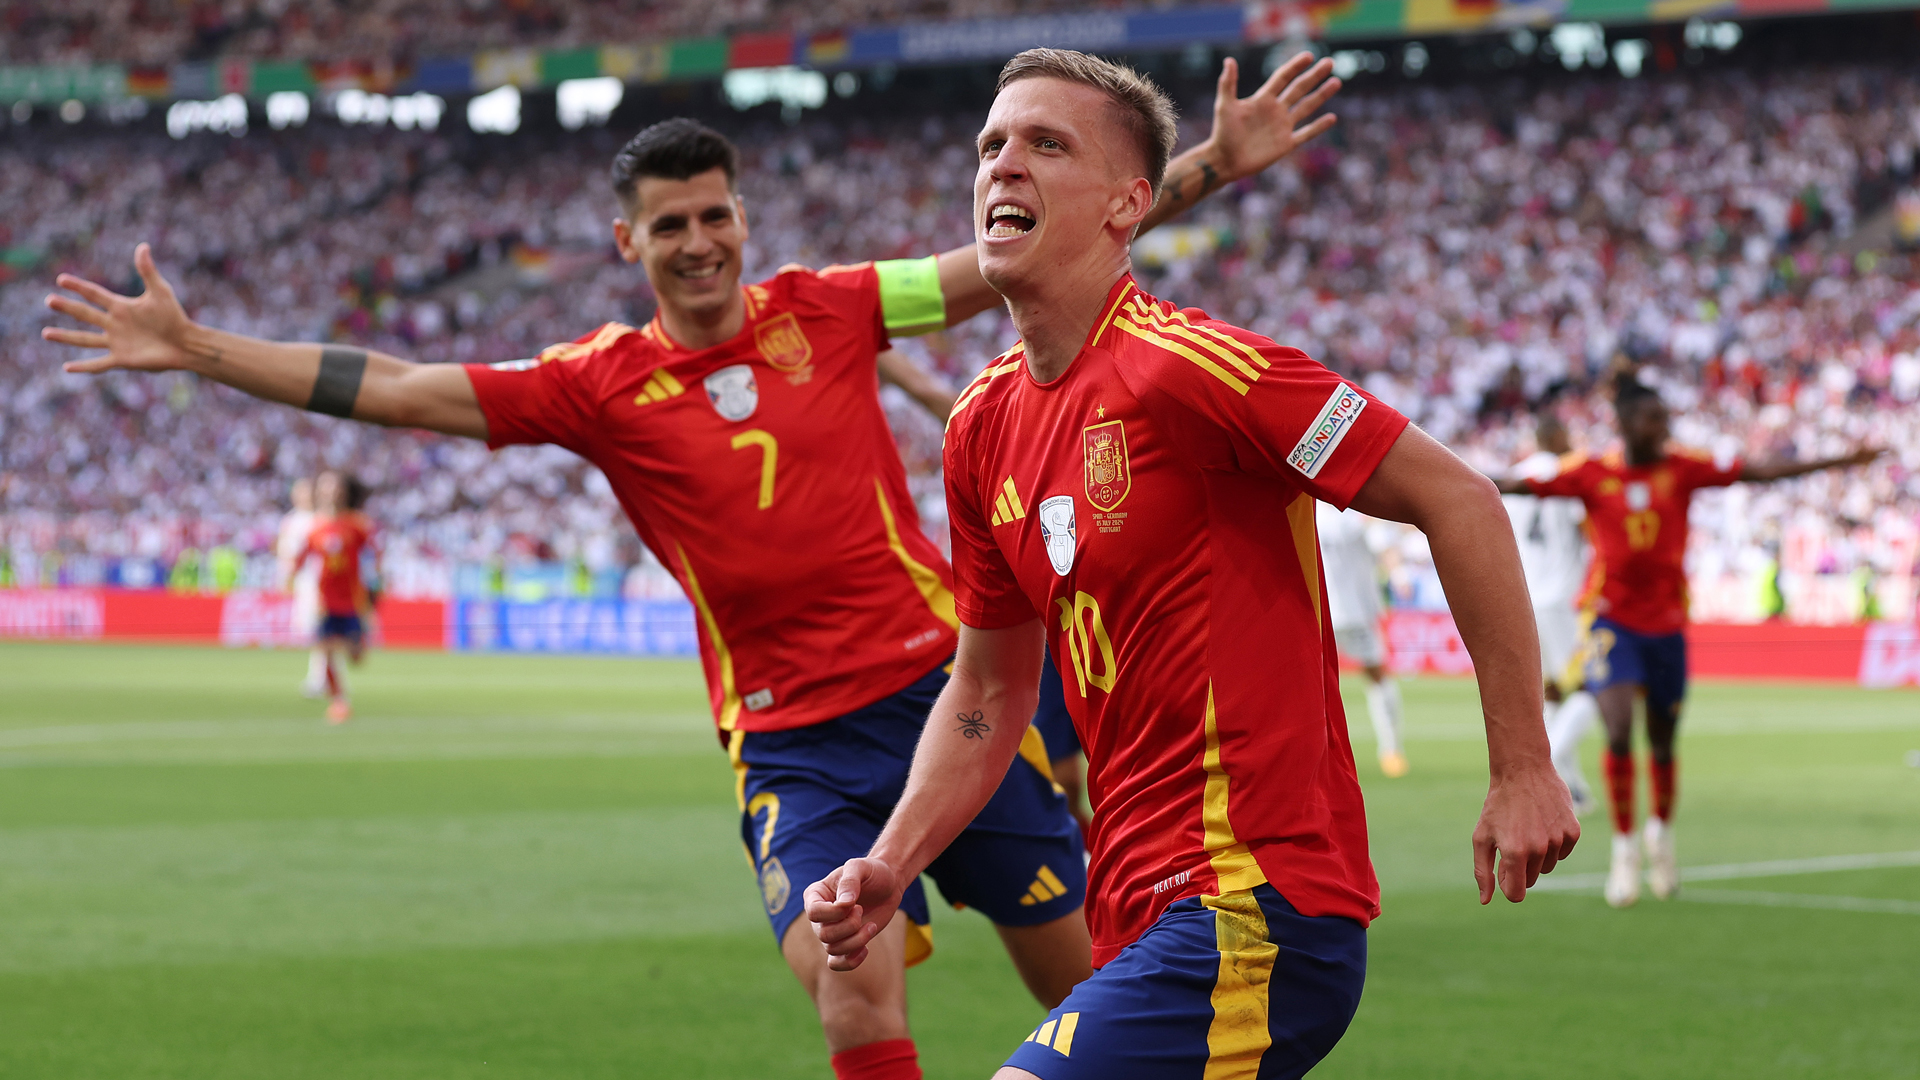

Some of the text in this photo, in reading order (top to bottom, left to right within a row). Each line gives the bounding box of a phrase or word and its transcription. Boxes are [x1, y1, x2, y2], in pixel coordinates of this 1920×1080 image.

[1290, 443, 1306, 464] UEFA
[1296, 389, 1357, 471] FOUNDATION
[731, 428, 778, 511] 7
[1054, 590, 1116, 698] 10
[747, 792, 780, 860] 7
[1154, 870, 1191, 894] HEAT.RDY
